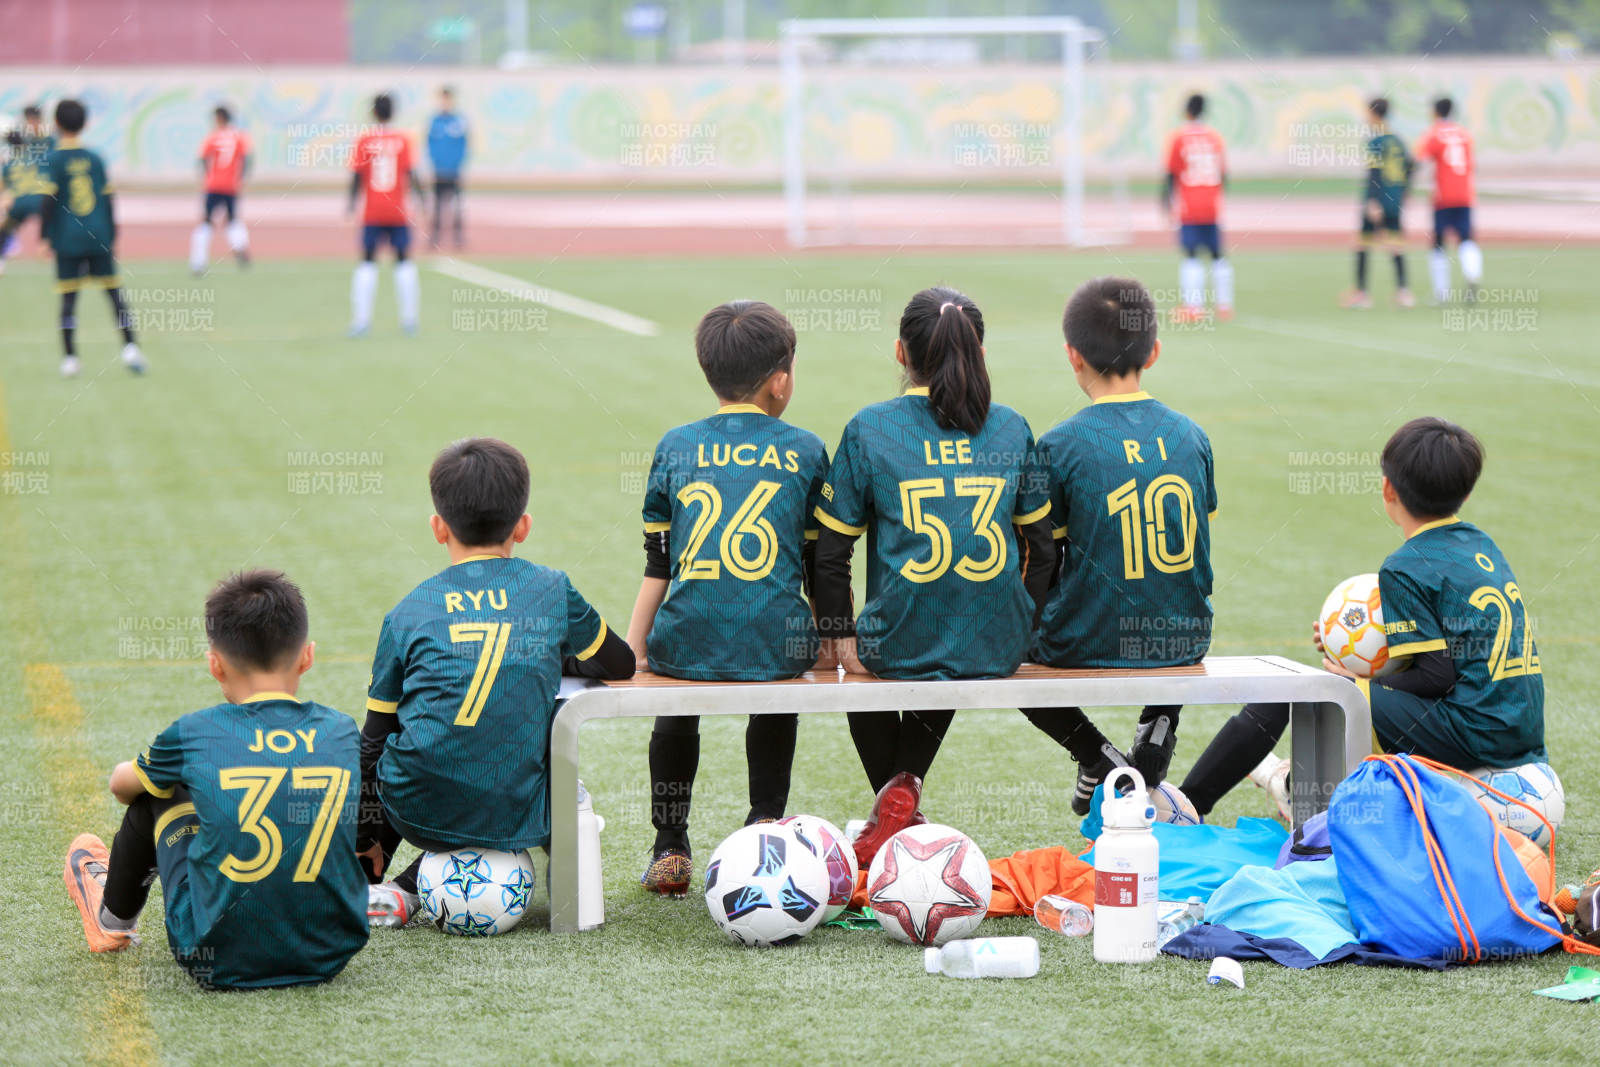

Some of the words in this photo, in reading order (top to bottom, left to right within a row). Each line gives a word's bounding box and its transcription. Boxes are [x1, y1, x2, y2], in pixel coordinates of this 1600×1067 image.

[698, 444, 800, 473] LUCAS
[924, 439, 973, 465] LEE
[677, 480, 782, 581] 26
[899, 476, 1007, 583] 53
[1107, 474, 1198, 580] 10
[1475, 553, 1495, 573] O
[446, 589, 509, 613] RYU
[449, 623, 512, 727] 7
[248, 729, 317, 754] JOY
[218, 767, 351, 883] 37
